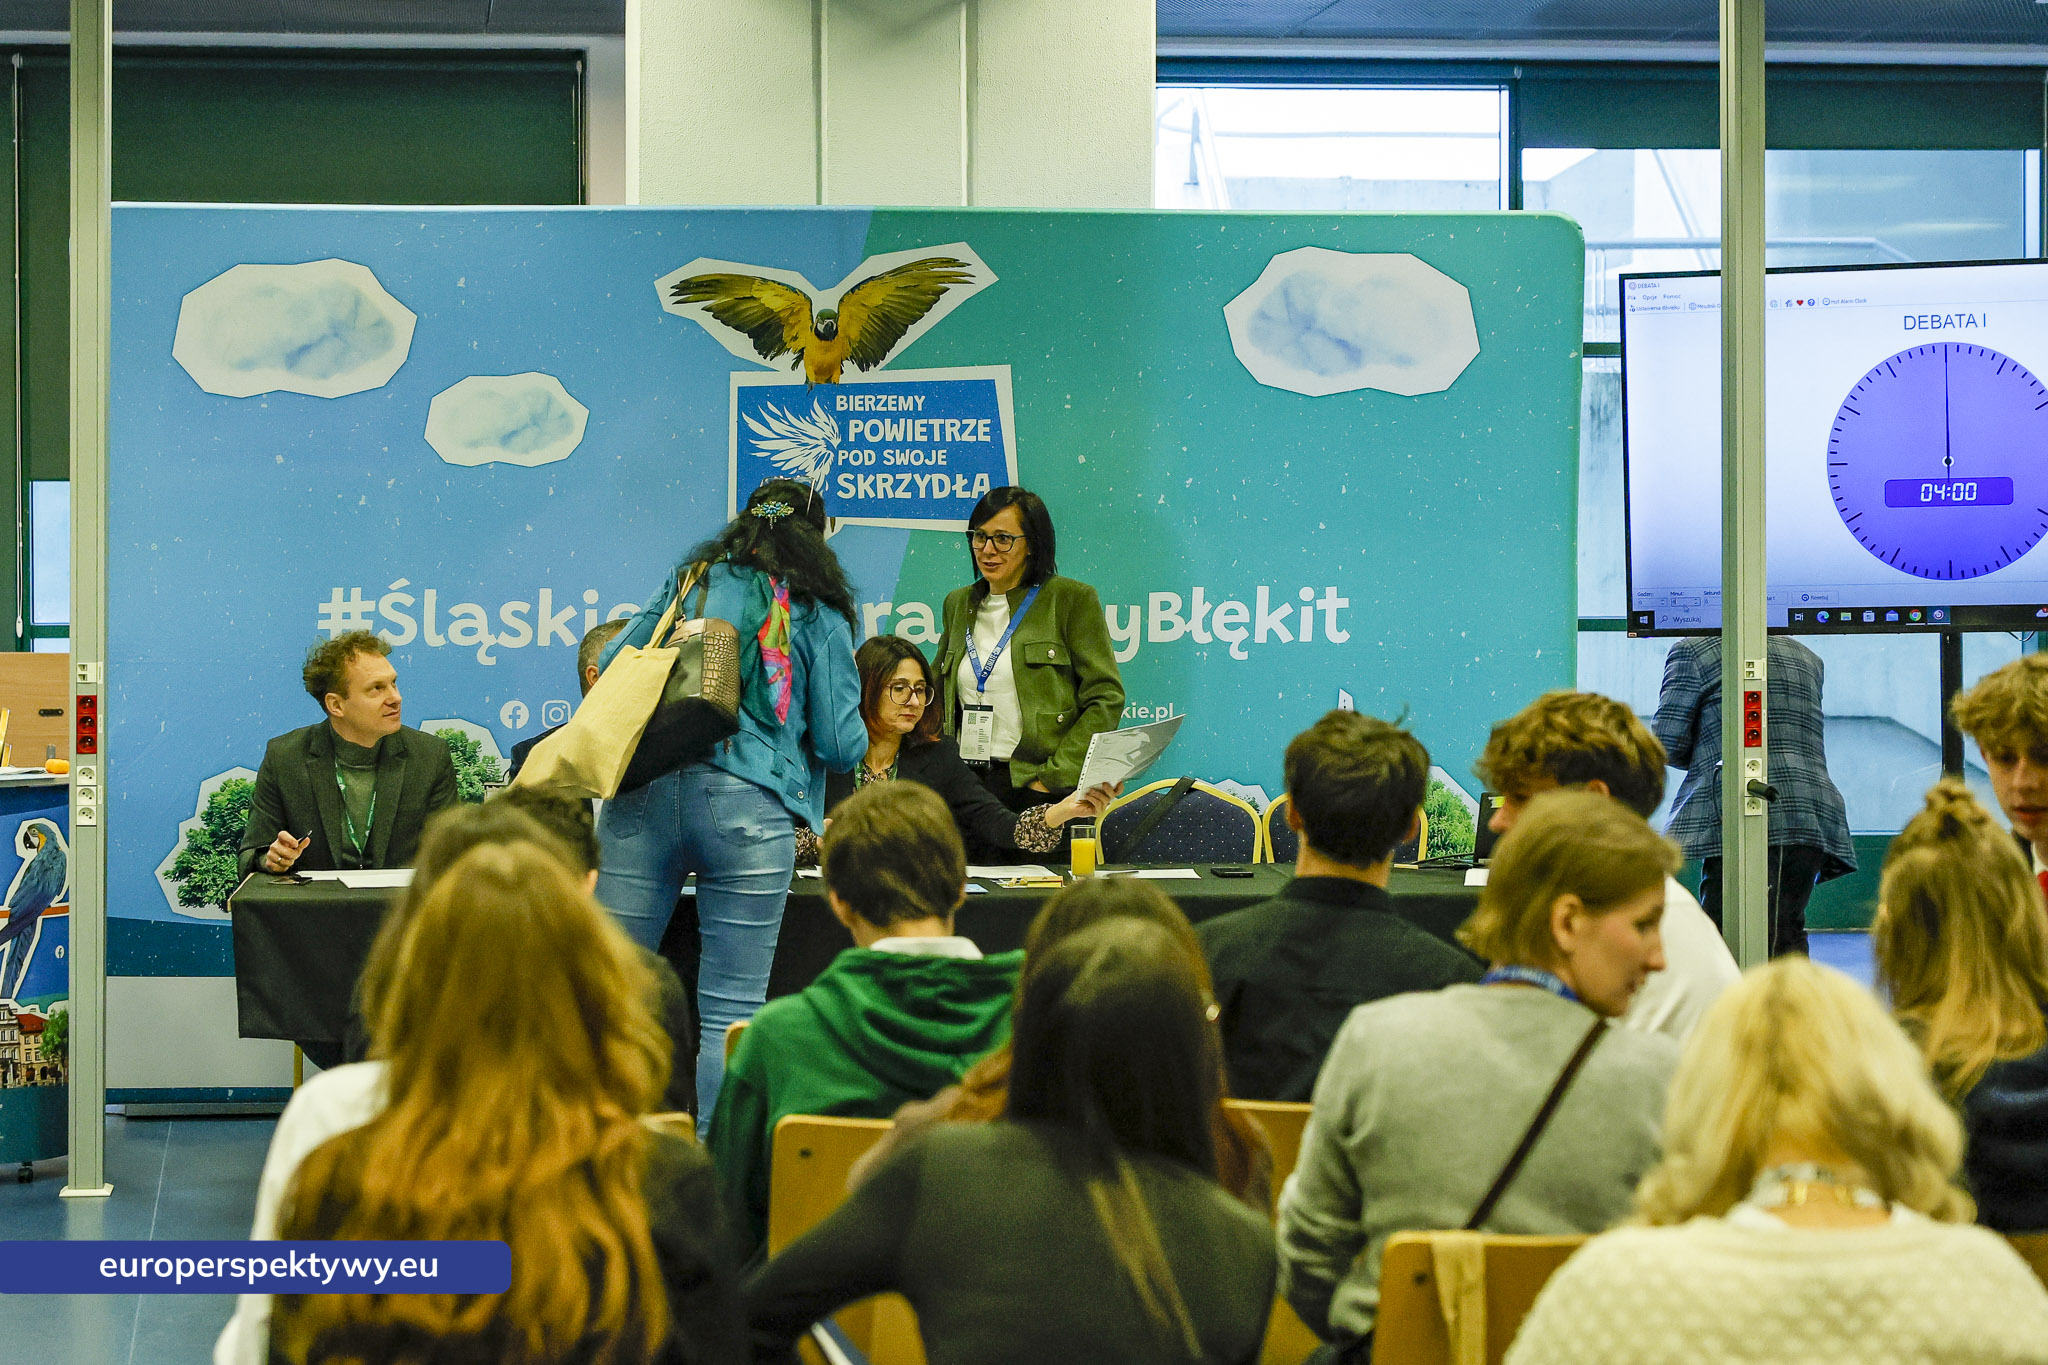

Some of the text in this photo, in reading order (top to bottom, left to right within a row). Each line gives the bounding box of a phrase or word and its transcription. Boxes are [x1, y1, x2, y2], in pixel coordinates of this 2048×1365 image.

[1903, 313, 1987, 330] DEBATA I
[836, 395, 926, 412] BIERZEMY
[849, 418, 992, 443] POWIETRZE
[838, 449, 948, 466] POD SWOJE
[837, 473, 991, 500] SKRZYDŁA
[1920, 482, 1978, 502] 04:00
